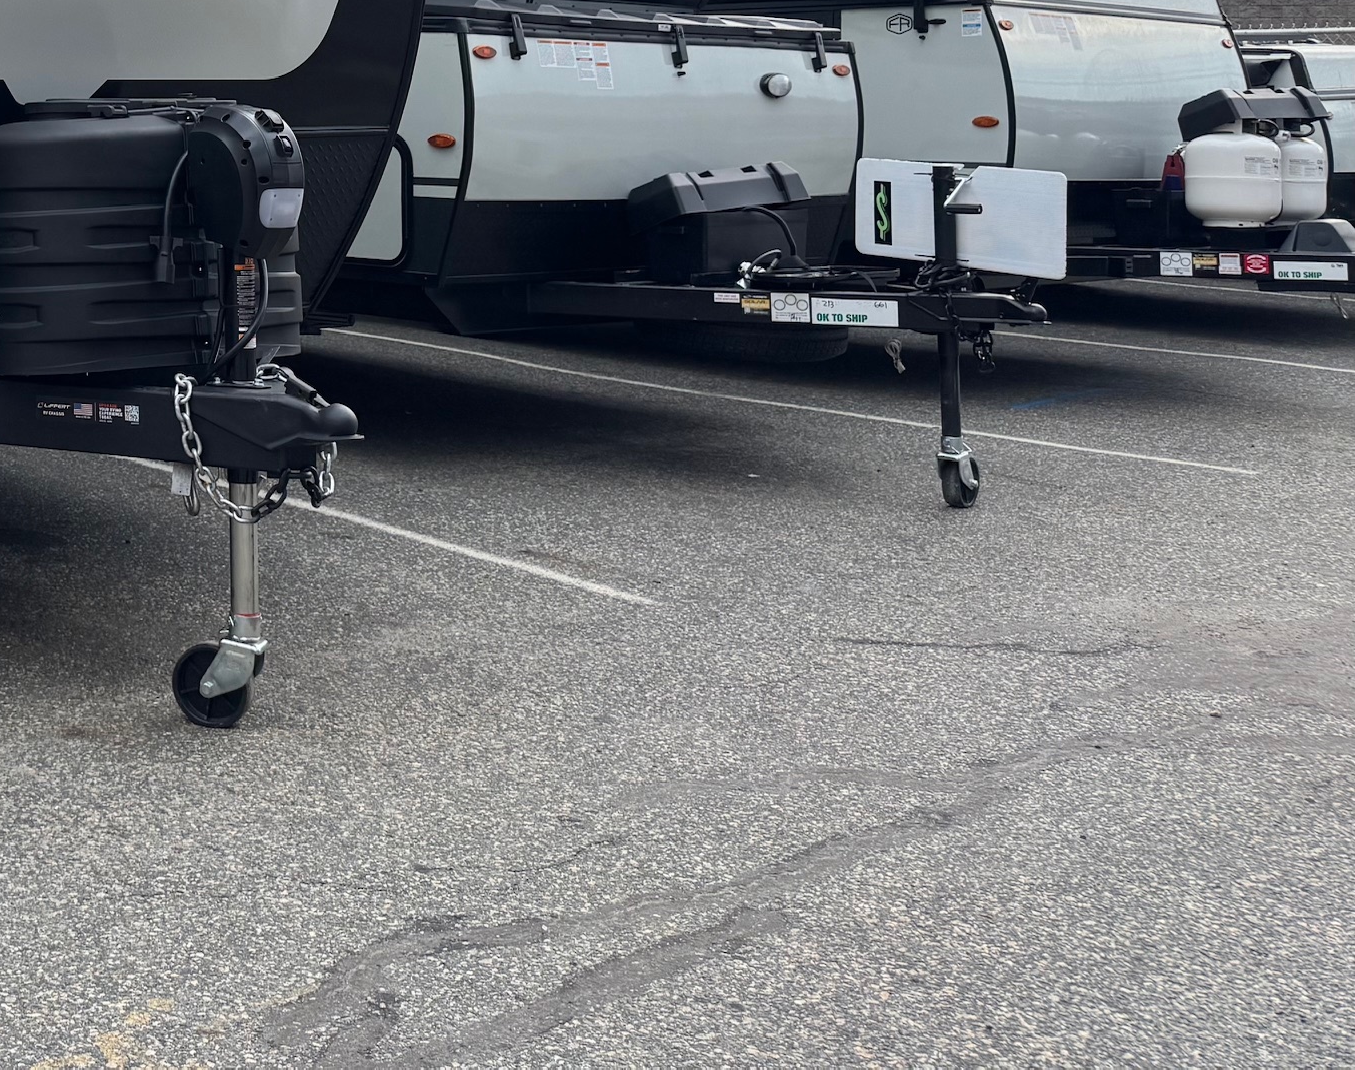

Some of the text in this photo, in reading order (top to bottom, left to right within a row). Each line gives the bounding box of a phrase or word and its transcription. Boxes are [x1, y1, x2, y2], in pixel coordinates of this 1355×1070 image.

[1278, 270, 1290, 278] OK
[1302, 271, 1323, 279] SHIP
[816, 313, 830, 322] OK
[832, 313, 844, 322] TO
[846, 314, 868, 323] SHIP
